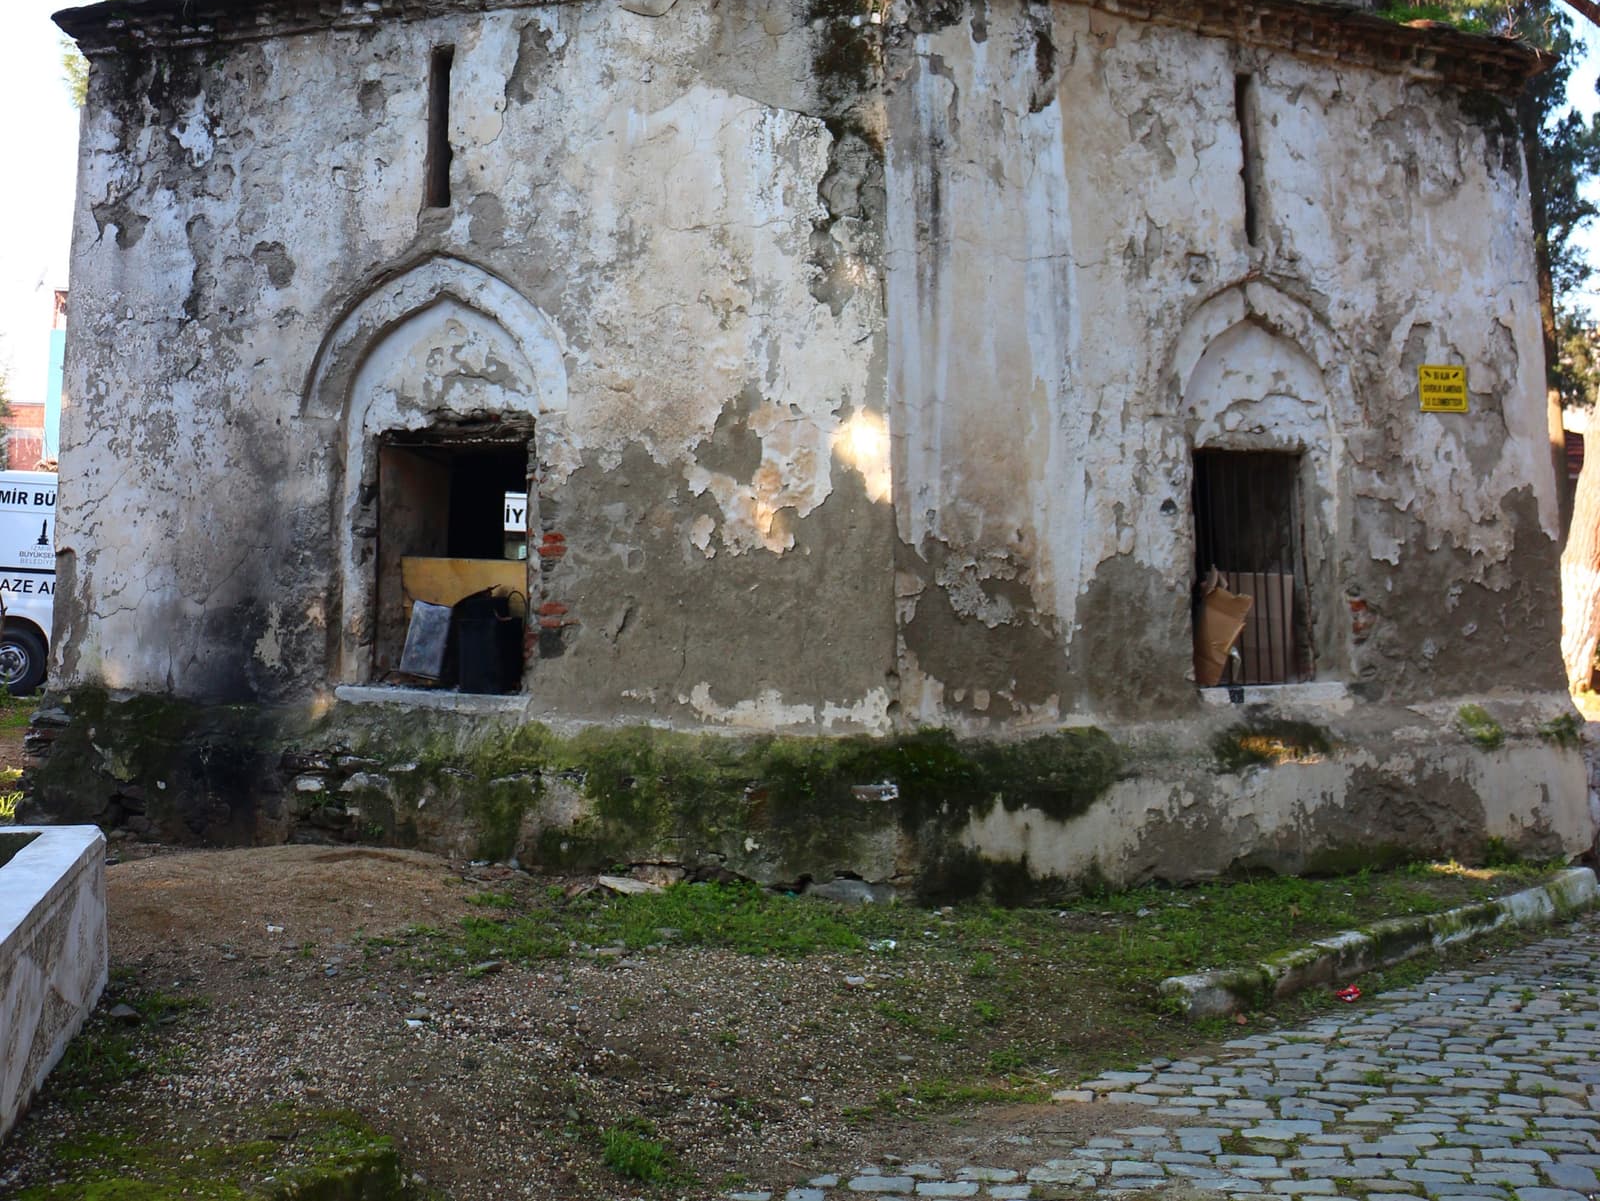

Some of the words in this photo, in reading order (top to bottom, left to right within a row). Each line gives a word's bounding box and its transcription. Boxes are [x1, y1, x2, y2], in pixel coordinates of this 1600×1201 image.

[0, 488, 28, 505] MİR
[34, 490, 56, 506] BÜ
[506, 504, 524, 523] İY
[0, 579, 34, 593] AZE
